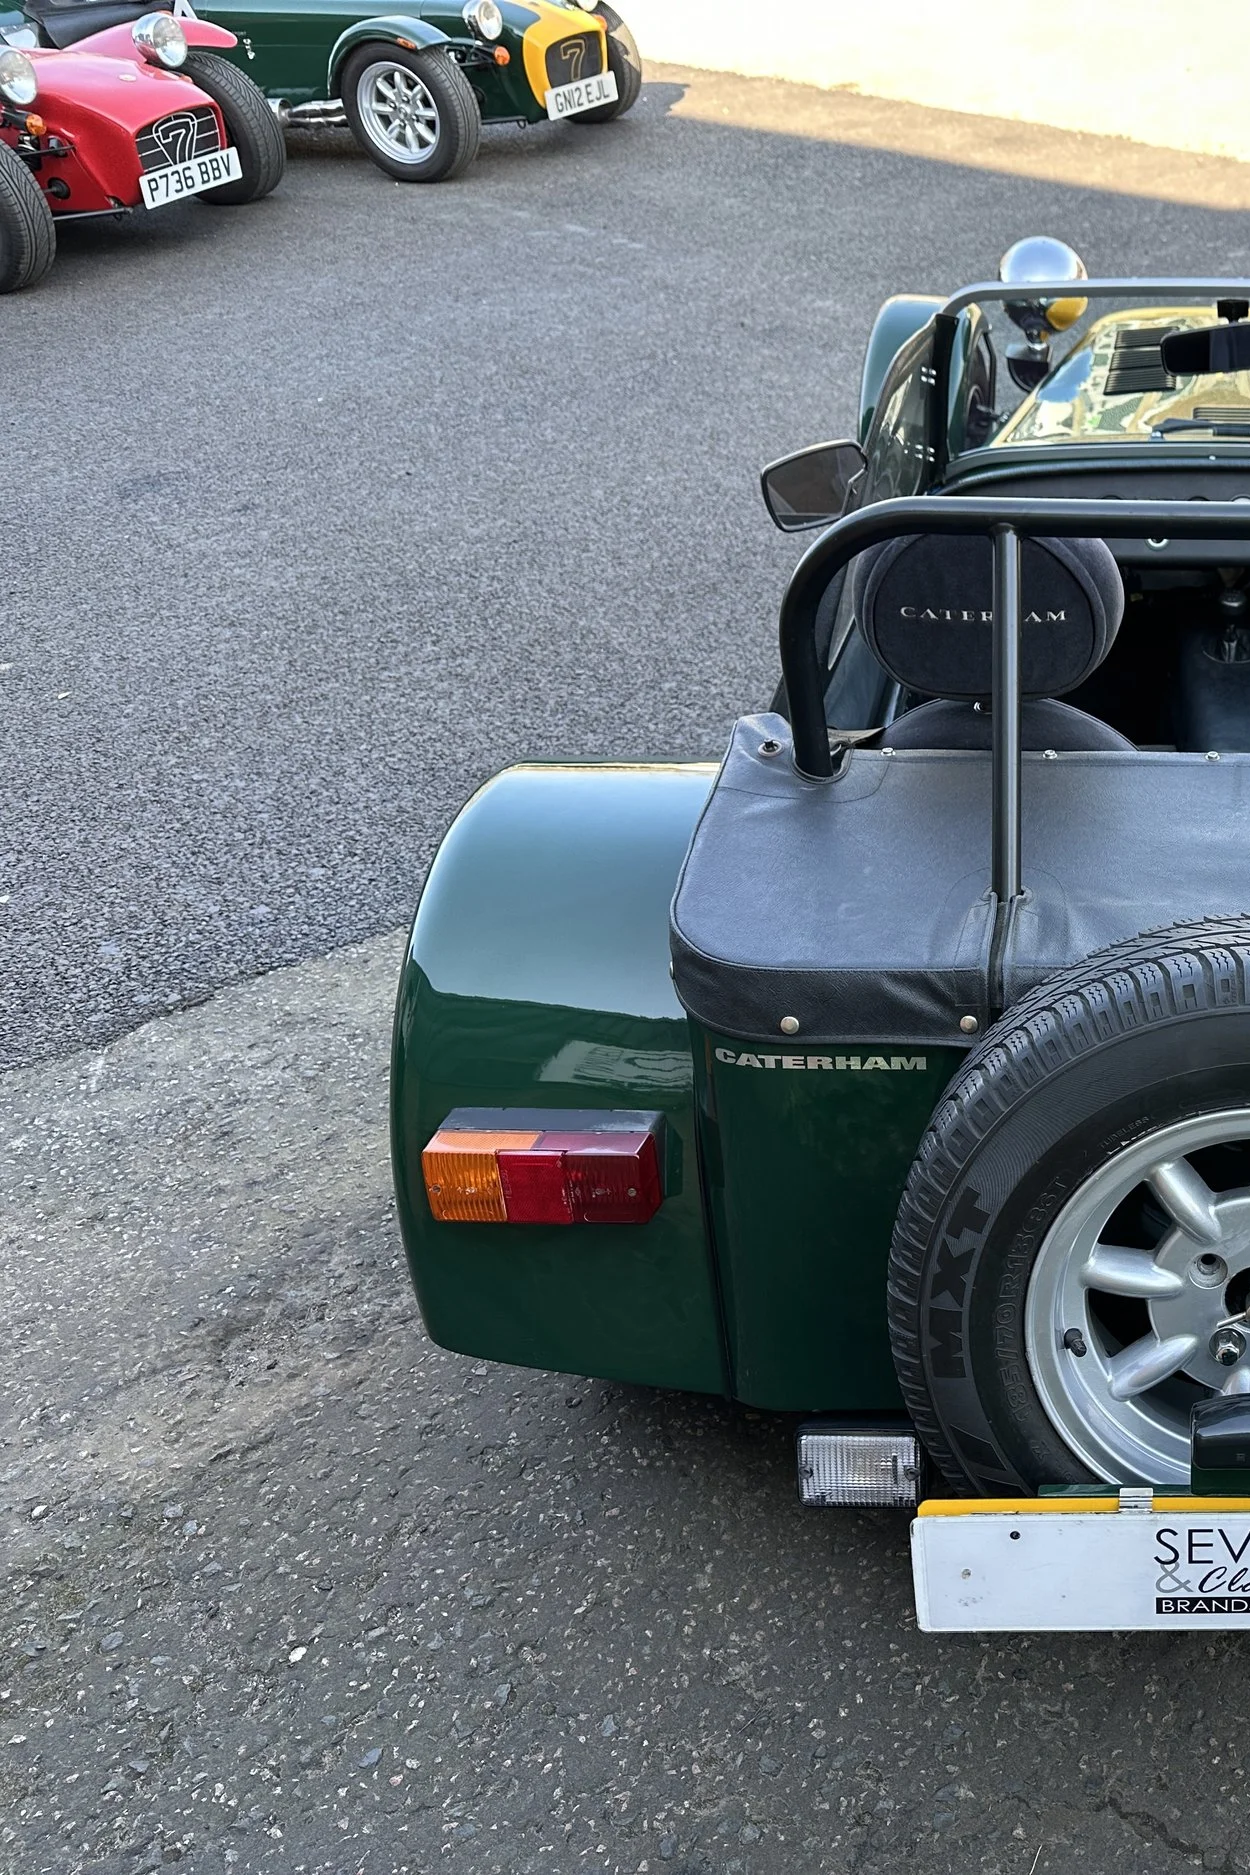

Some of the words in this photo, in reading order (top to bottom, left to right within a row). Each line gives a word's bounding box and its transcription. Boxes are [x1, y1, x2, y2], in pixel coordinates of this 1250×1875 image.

[560, 38, 586, 81] 7
[554, 87, 584, 113] GN12
[584, 79, 610, 104] EJL
[158, 117, 194, 164] 7
[147, 166, 196, 203] P736
[197, 153, 231, 185] BBV
[900, 606, 1067, 622] CATERAM
[714, 1047, 928, 1071] CATERHAM
[928, 1185, 991, 1379] MXT
[1155, 1558, 1195, 1594] &
